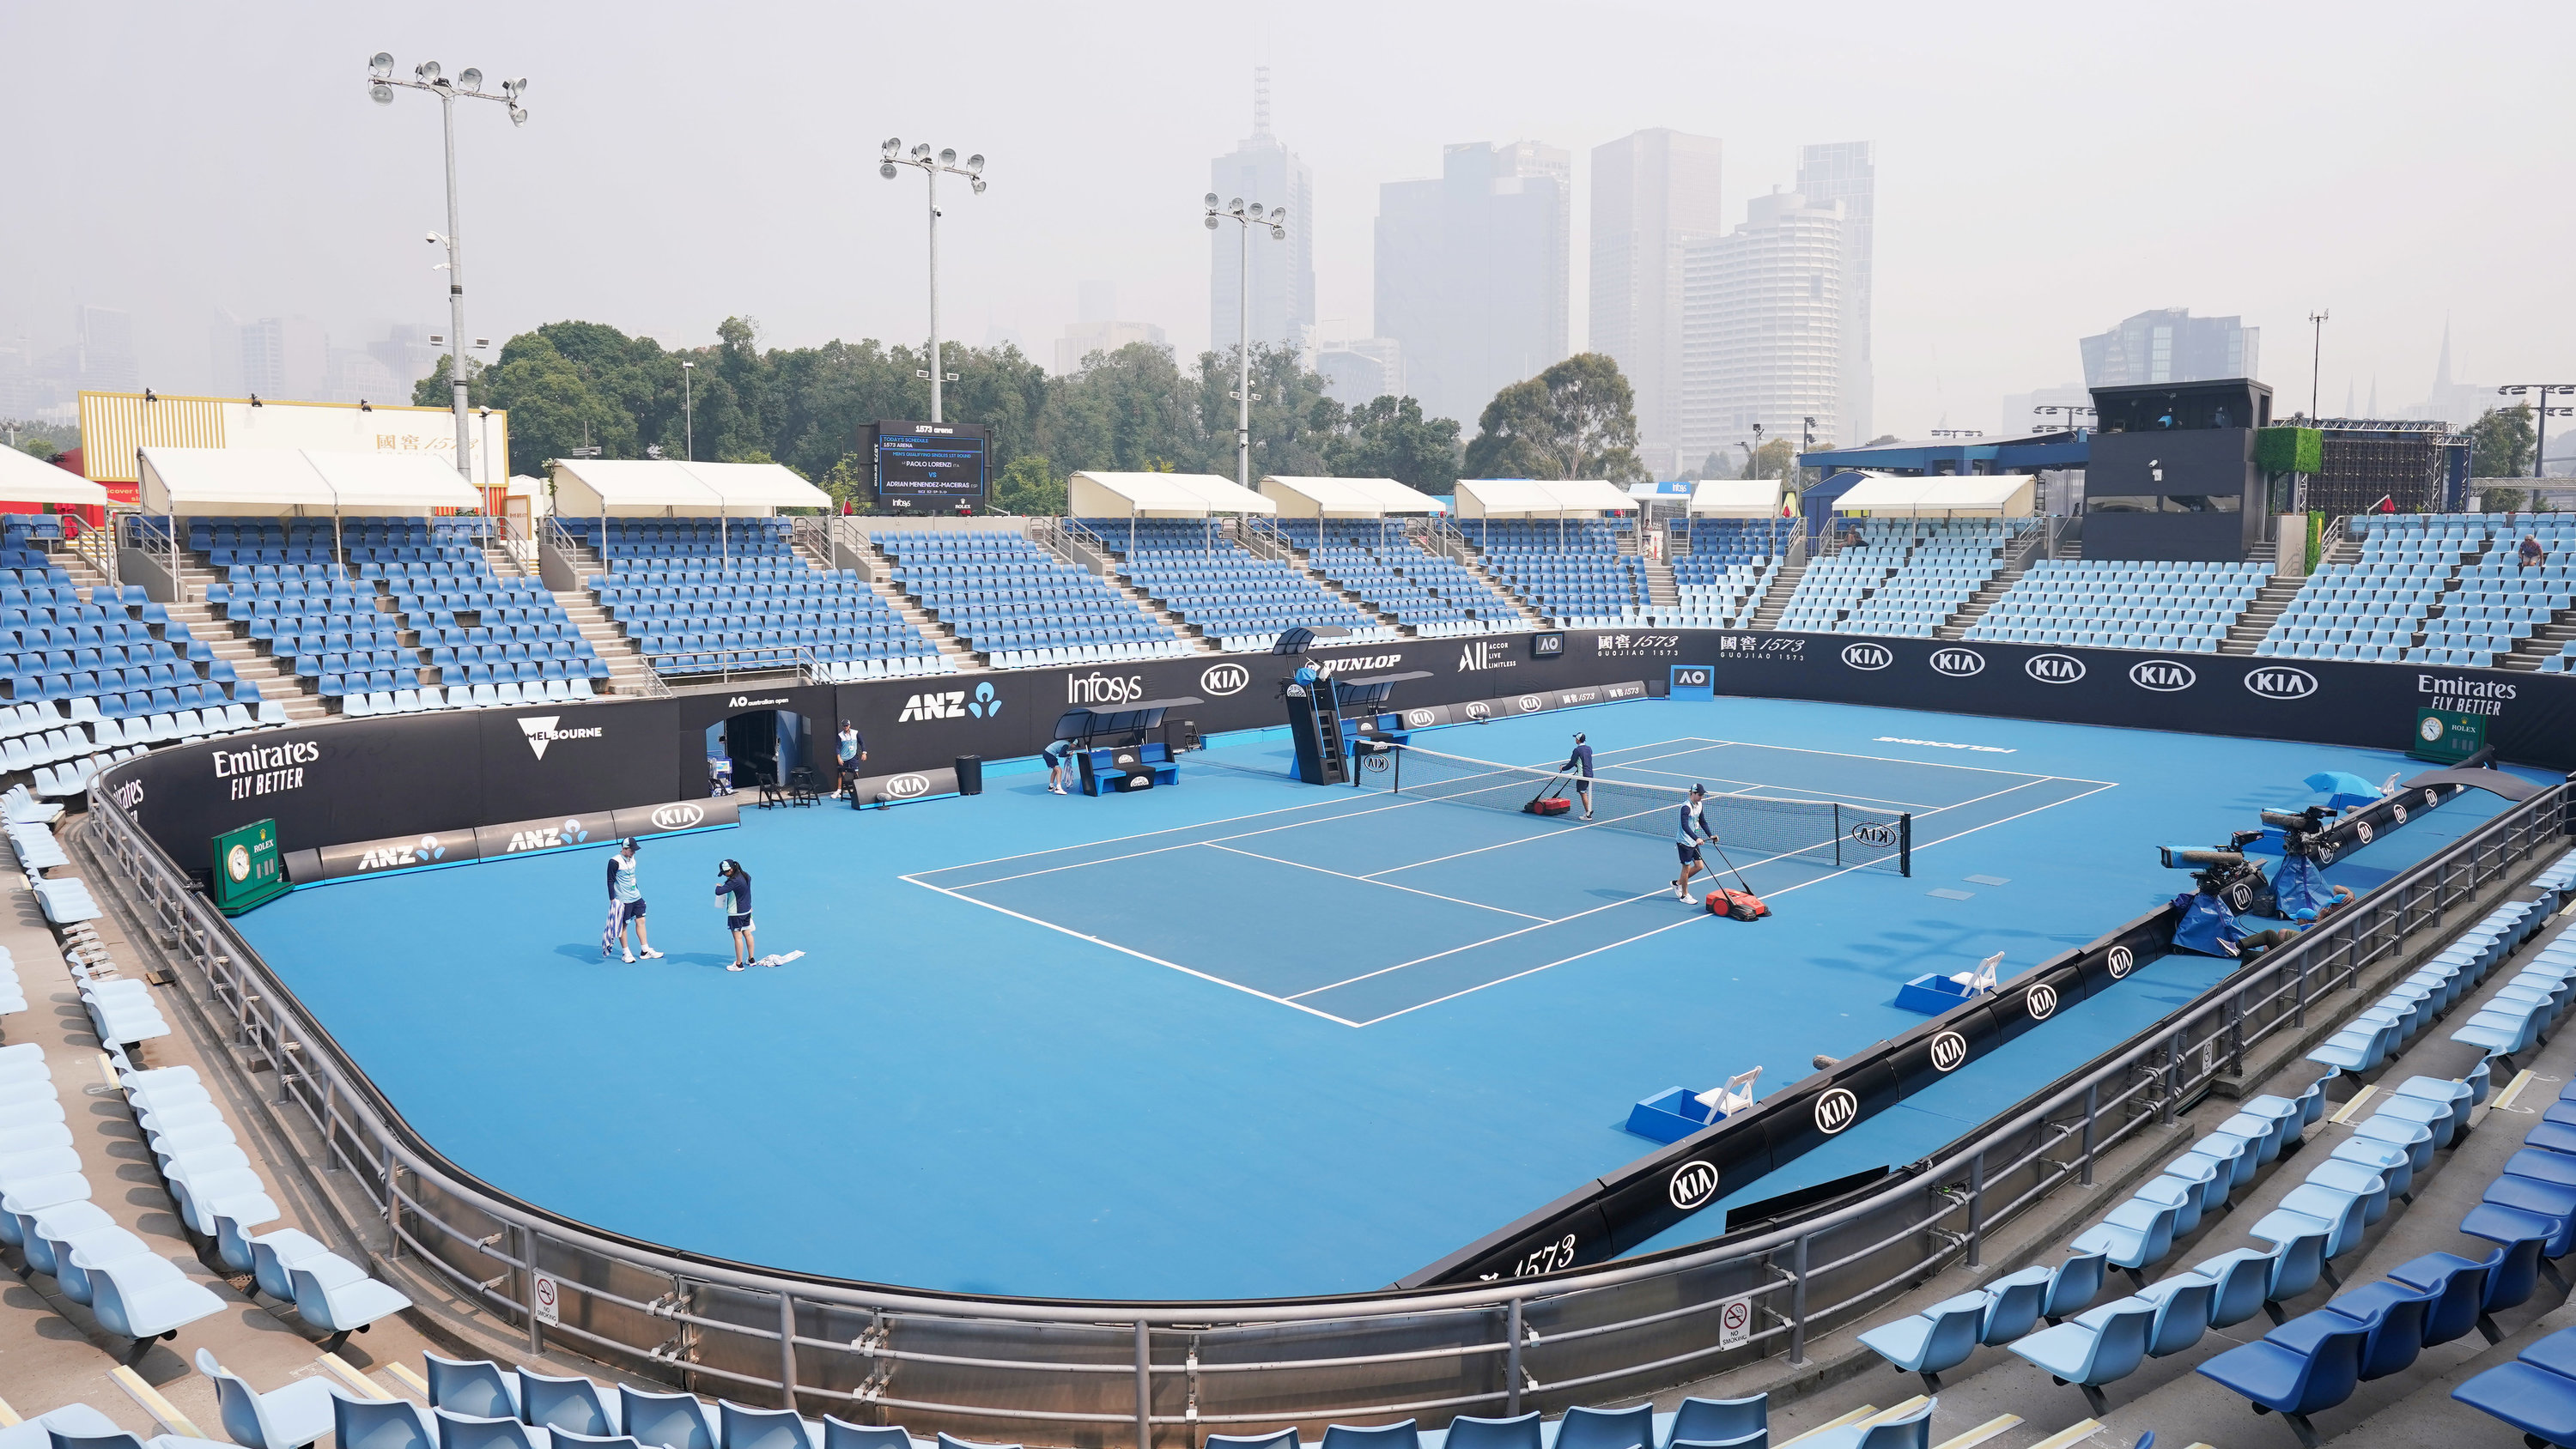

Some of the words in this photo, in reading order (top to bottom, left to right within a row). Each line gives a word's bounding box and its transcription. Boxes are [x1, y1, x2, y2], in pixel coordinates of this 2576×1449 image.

[893, 499, 910, 507] Infosys
[1598, 634, 1631, 650] 國窖
[1632, 635, 1679, 648] 1573
[1720, 636, 1757, 651] 國窖
[1759, 638, 1805, 652] 1573
[1324, 654, 1401, 672] DUNLOP
[1488, 660, 1516, 669] LIMITLESS
[1679, 670, 1705, 684] AO
[1068, 671, 1142, 704] Infosys
[1624, 687, 1639, 696] 1573
[2418, 674, 2517, 700] Emirates
[728, 696, 748, 707] AO
[1578, 692, 1595, 702] 1573
[898, 690, 966, 722] ANZ
[2432, 696, 2454, 711] FLY
[2457, 698, 2501, 716] BETTER
[526, 727, 602, 741] MELBOURNE
[2451, 724, 2476, 733] ROLEX
[212, 741, 319, 779] Emirates
[231, 776, 252, 800] FLY
[256, 767, 303, 796] BETTER
[113, 779, 143, 809] irates
[253, 839, 274, 853] ROLEX
[507, 827, 562, 852] ANZ
[358, 846, 416, 870] ANZ
[538, 1309, 556, 1321] SMOKING
[1722, 1335, 1747, 1345] SMOKING
